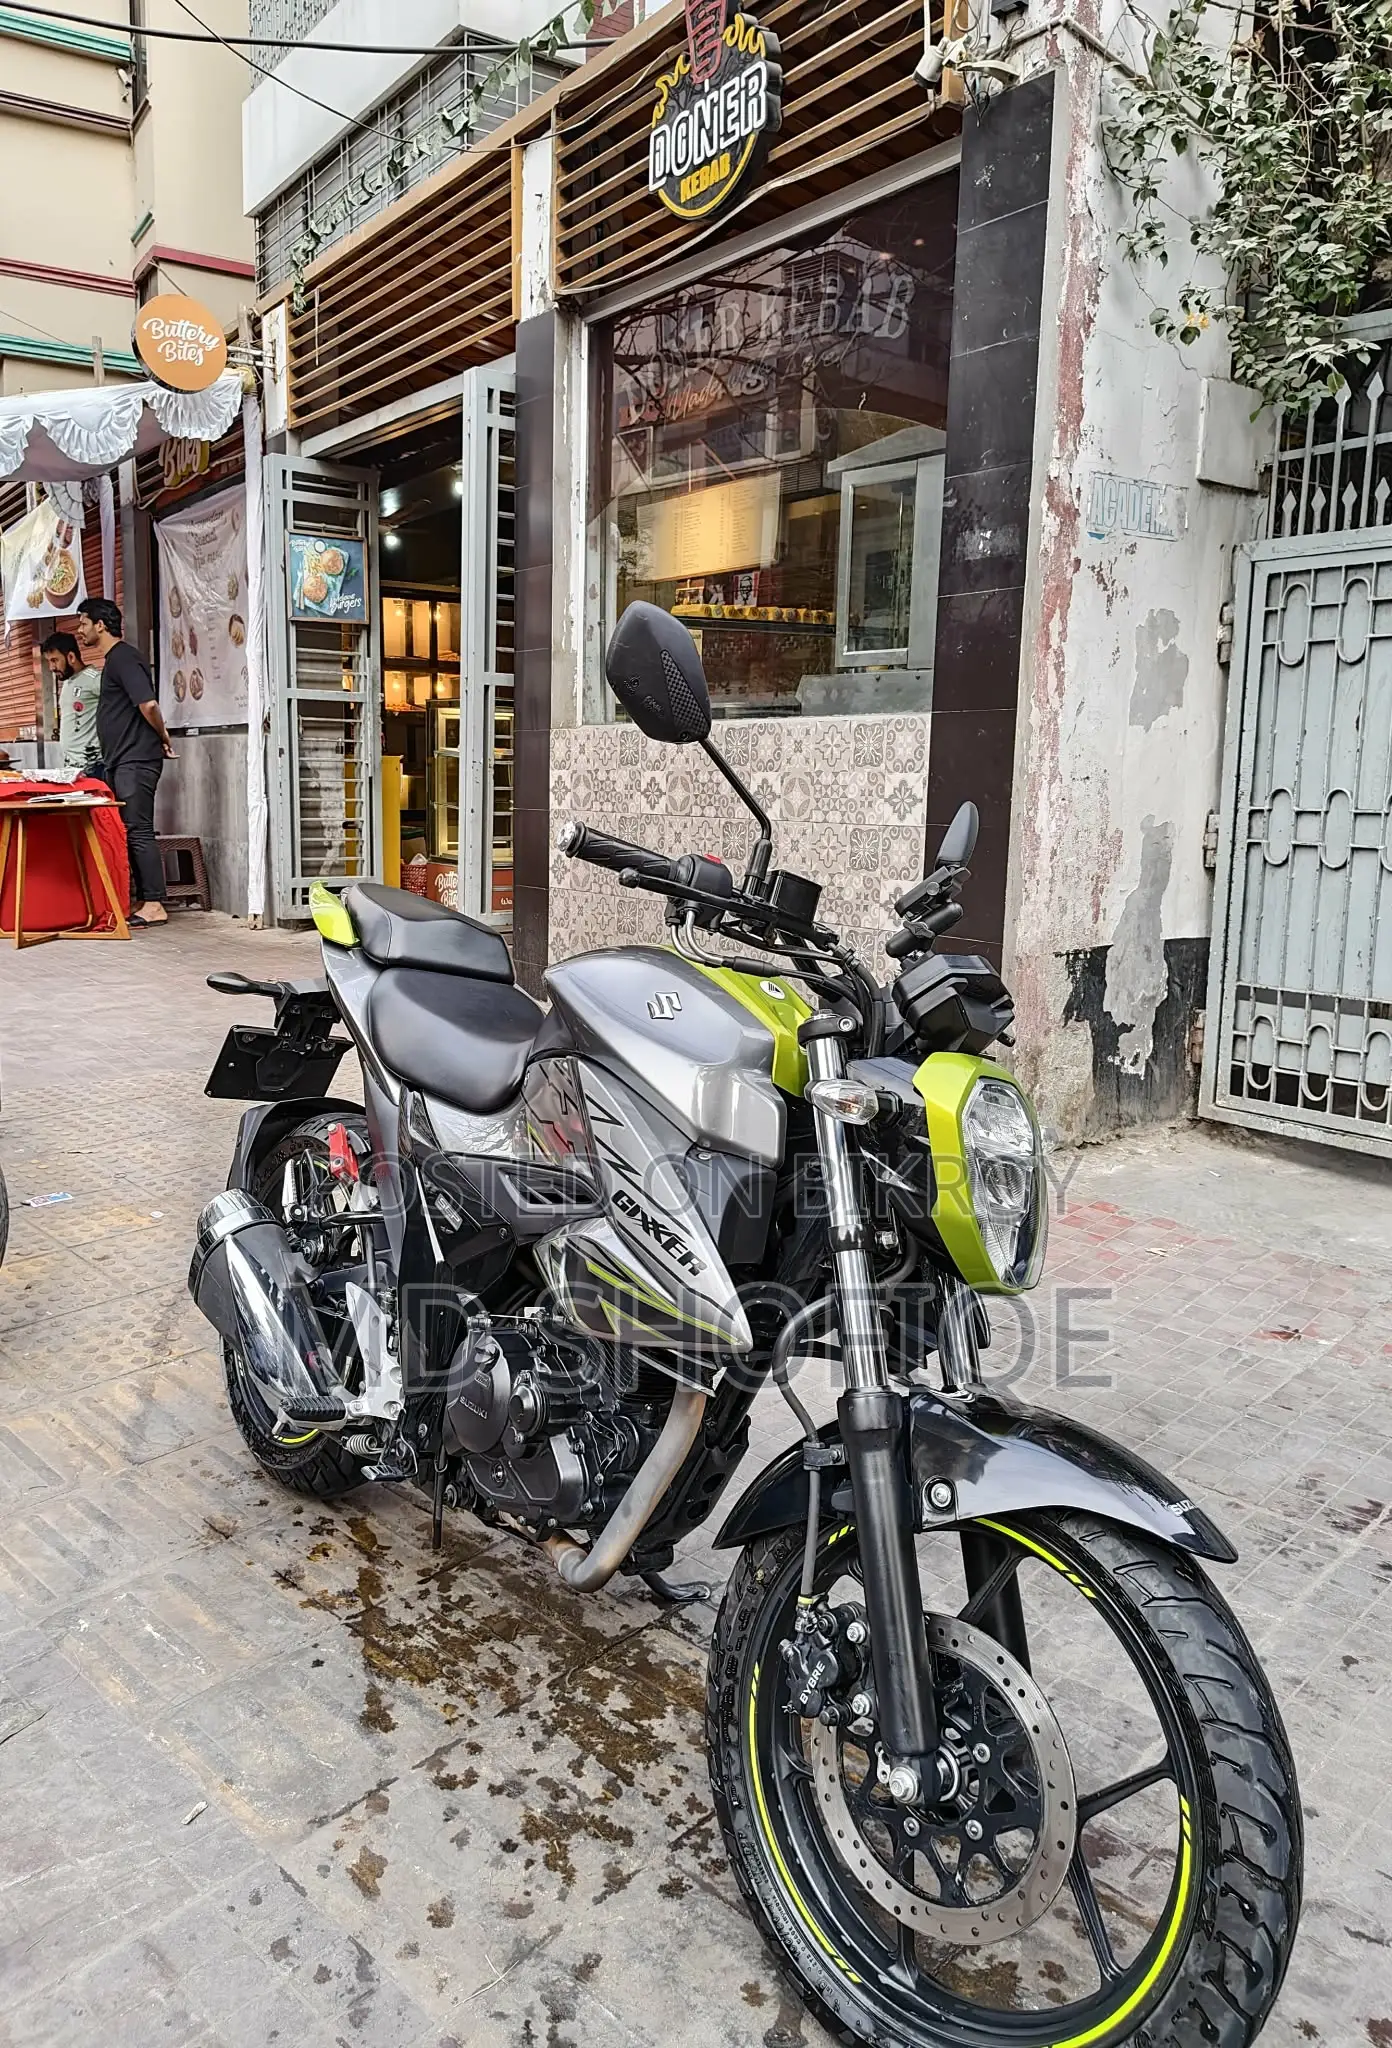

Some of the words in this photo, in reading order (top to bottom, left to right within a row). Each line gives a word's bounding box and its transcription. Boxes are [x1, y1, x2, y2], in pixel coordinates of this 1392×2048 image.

[648, 61, 767, 192] DONER
[680, 152, 732, 204] KEBAB
[757, 272, 916, 342] KEBAB
[142, 317, 220, 351] Buttery
[157, 340, 204, 366] Bites
[1090, 476, 1174, 537] ACADE
[610, 1189, 708, 1277] GIXXER
[459, 1396, 489, 1420] SUZUKI
[799, 1660, 826, 1705] BYBRE
